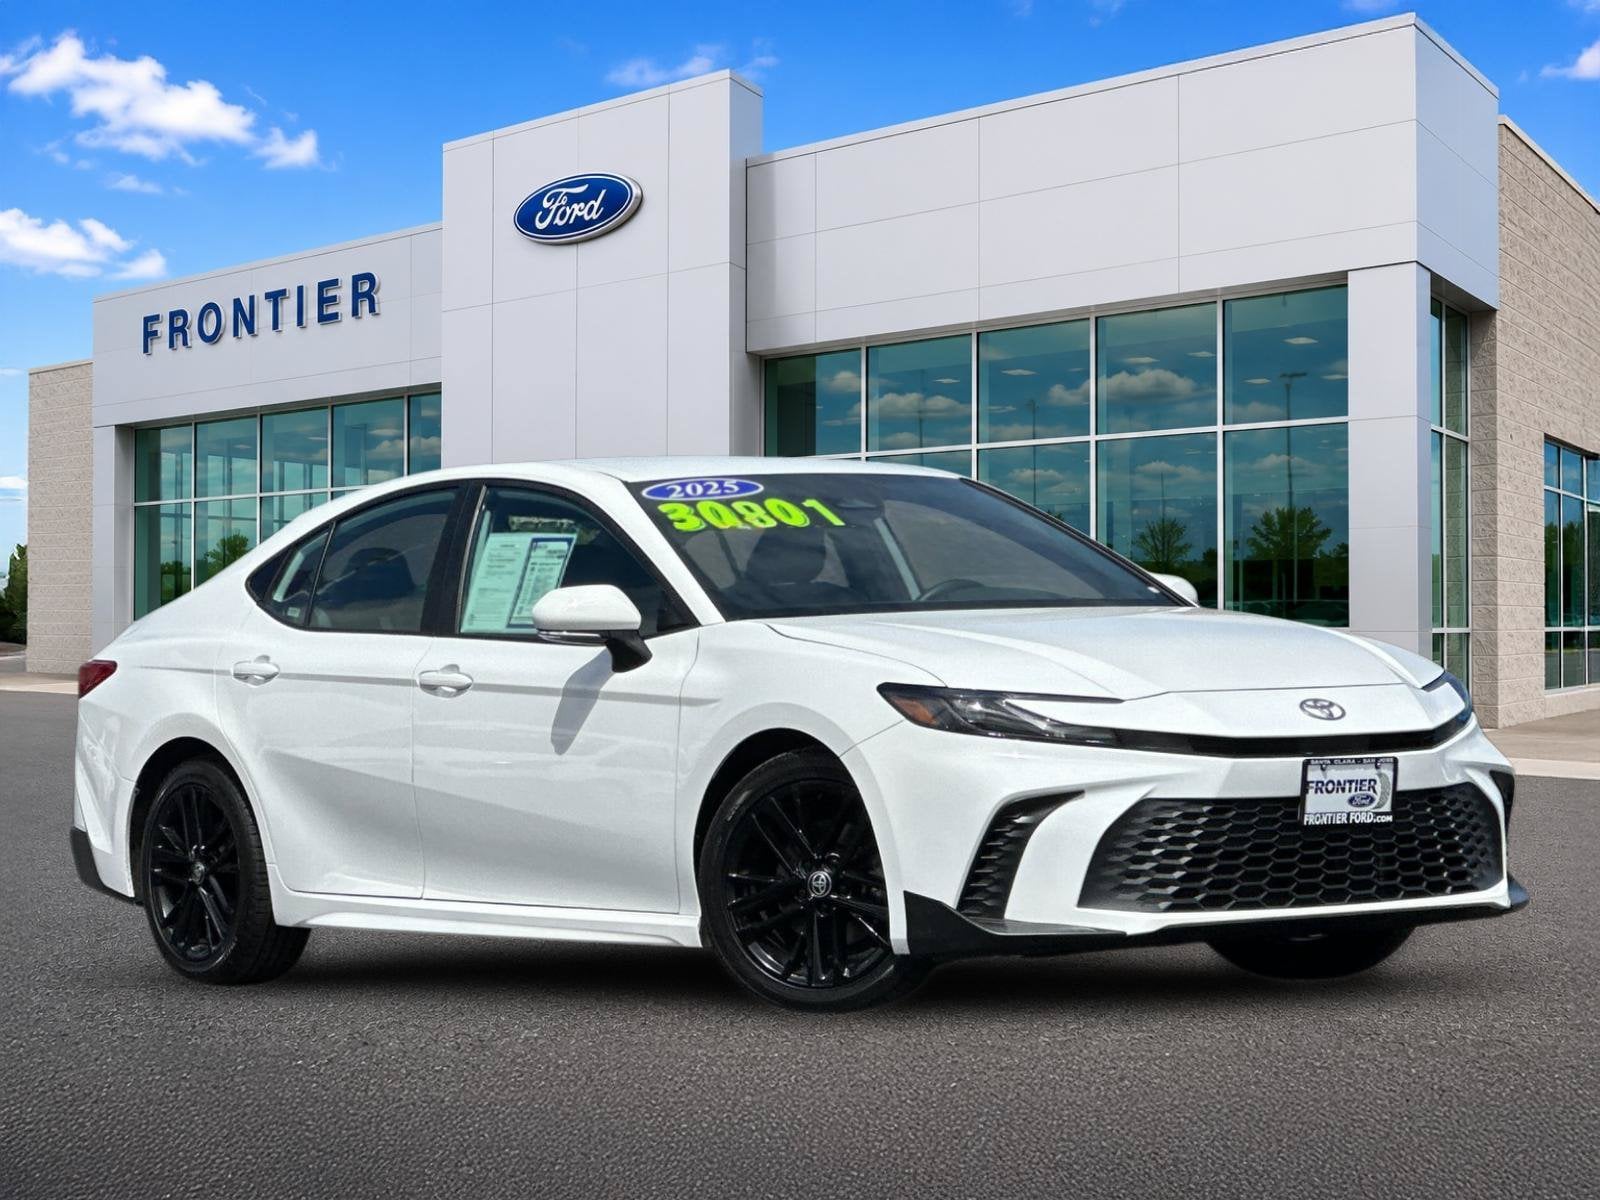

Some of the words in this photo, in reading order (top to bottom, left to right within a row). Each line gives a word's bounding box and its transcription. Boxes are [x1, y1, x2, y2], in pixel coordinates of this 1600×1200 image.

[535, 184, 607, 230] Ford
[142, 272, 381, 355] FRONTIER
[666, 480, 740, 500] 2025
[657, 498, 846, 532] 30801
[1306, 779, 1378, 795] FRONTIER
[1304, 813, 1347, 825] FRONTIER
